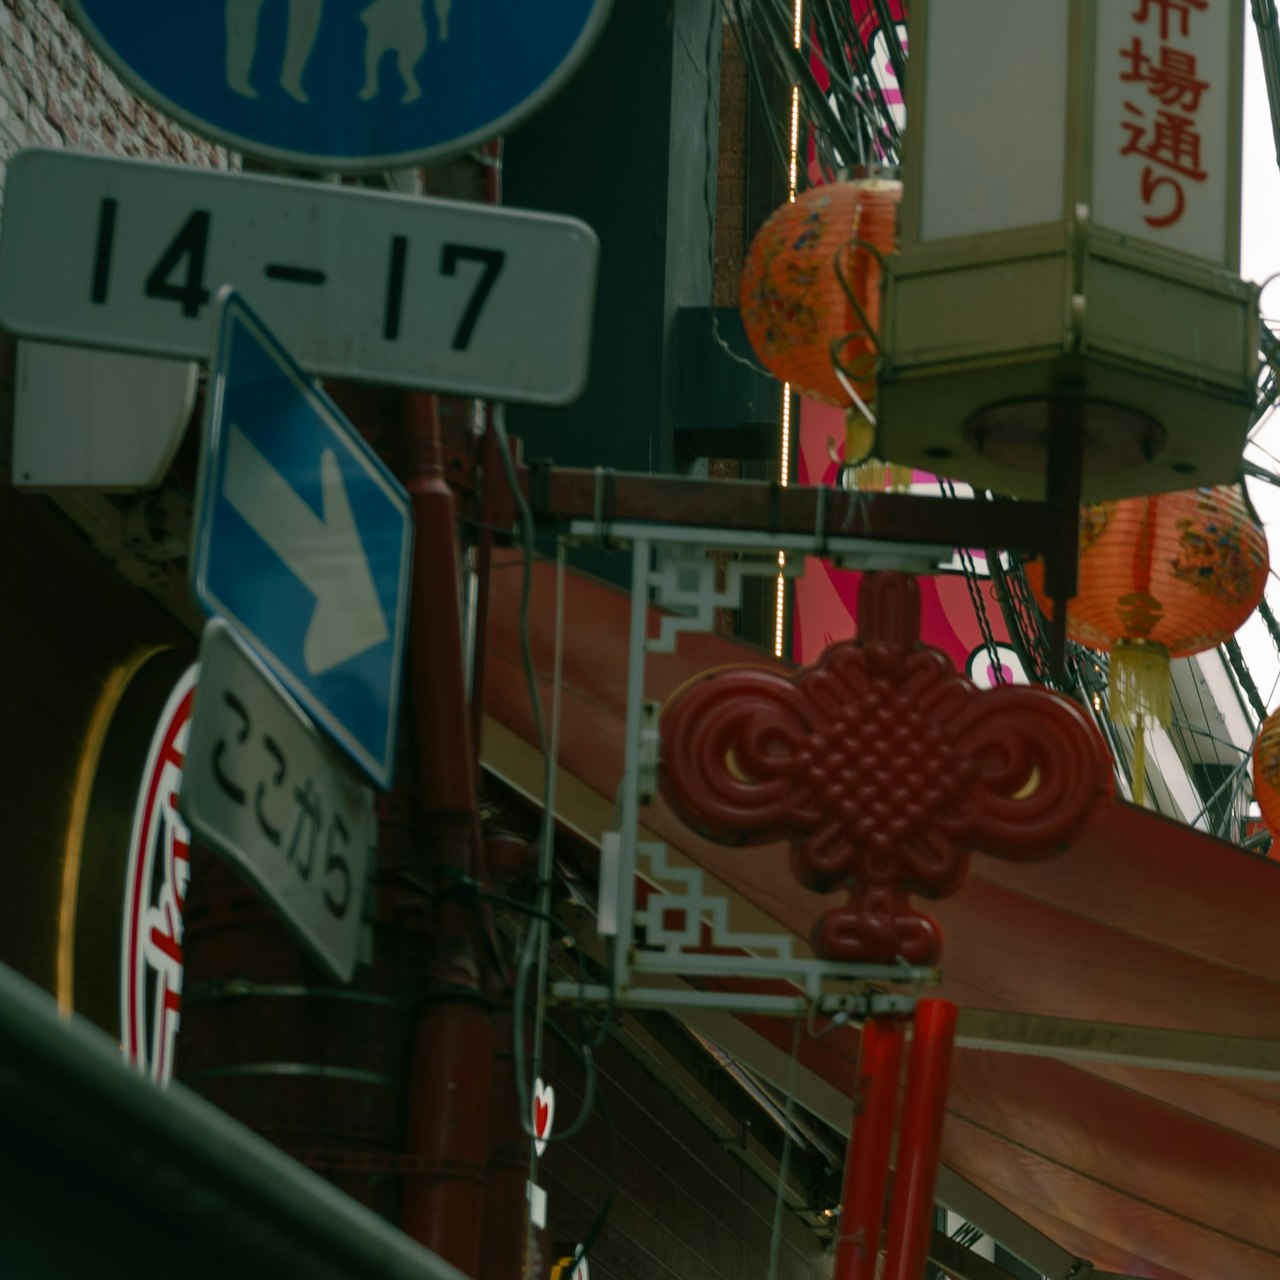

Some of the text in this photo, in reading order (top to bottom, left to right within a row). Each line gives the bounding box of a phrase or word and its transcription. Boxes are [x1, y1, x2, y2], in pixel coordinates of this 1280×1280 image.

[90, 197, 506, 352] 14-17
[210, 690, 352, 920] ここから
